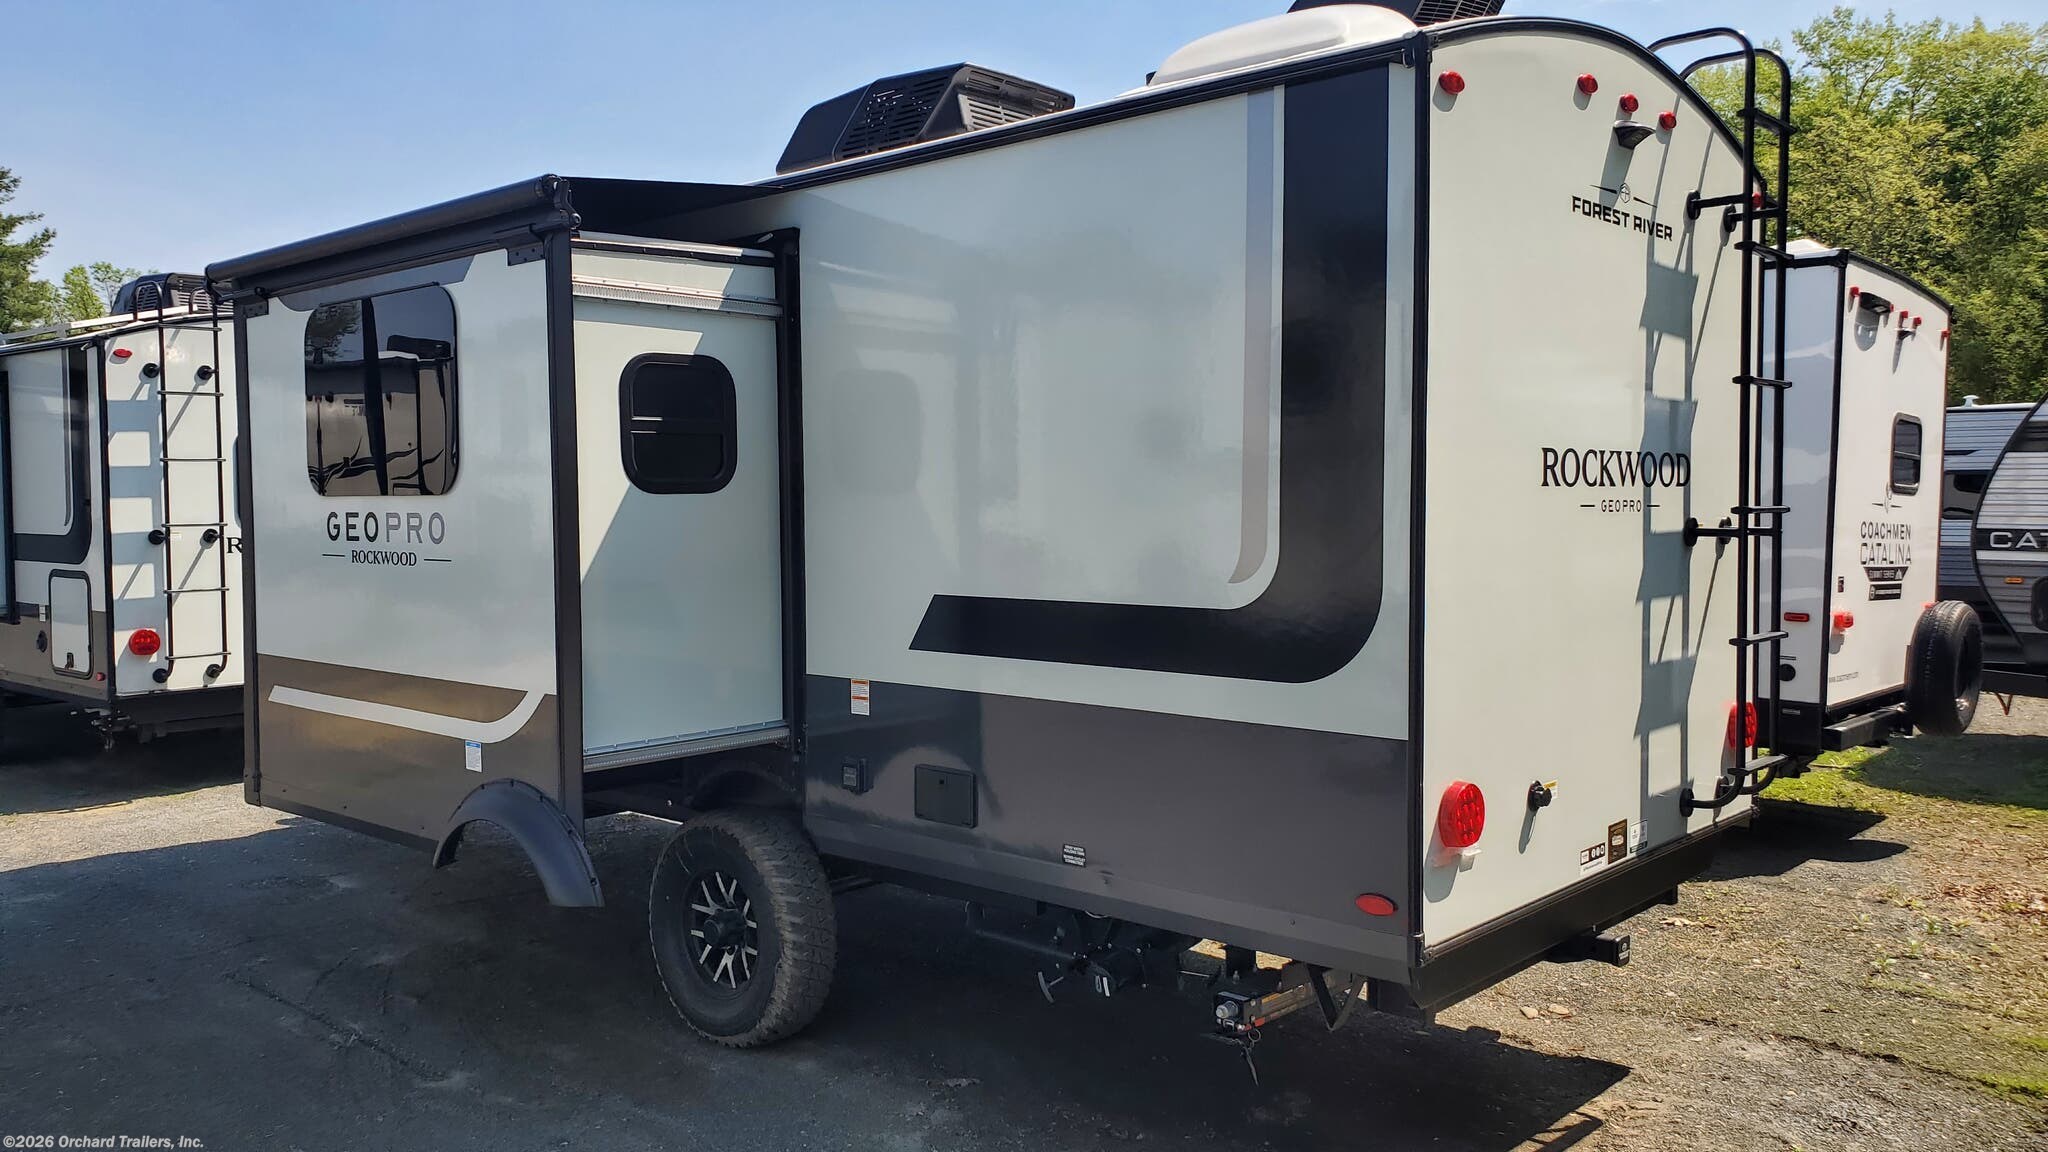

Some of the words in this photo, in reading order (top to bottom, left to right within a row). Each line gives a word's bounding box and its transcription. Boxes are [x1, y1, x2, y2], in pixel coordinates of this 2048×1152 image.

[1572, 195, 1630, 228] FOREST
[1633, 215, 1673, 241] RIVER
[1541, 447, 1691, 488] ROCKWOOD
[1600, 499, 1642, 513] GEOPRO
[1860, 521, 1912, 540] COACHMEN
[351, 549, 418, 567] ROCKWOOD
[1860, 542, 1912, 566] CATALINA
